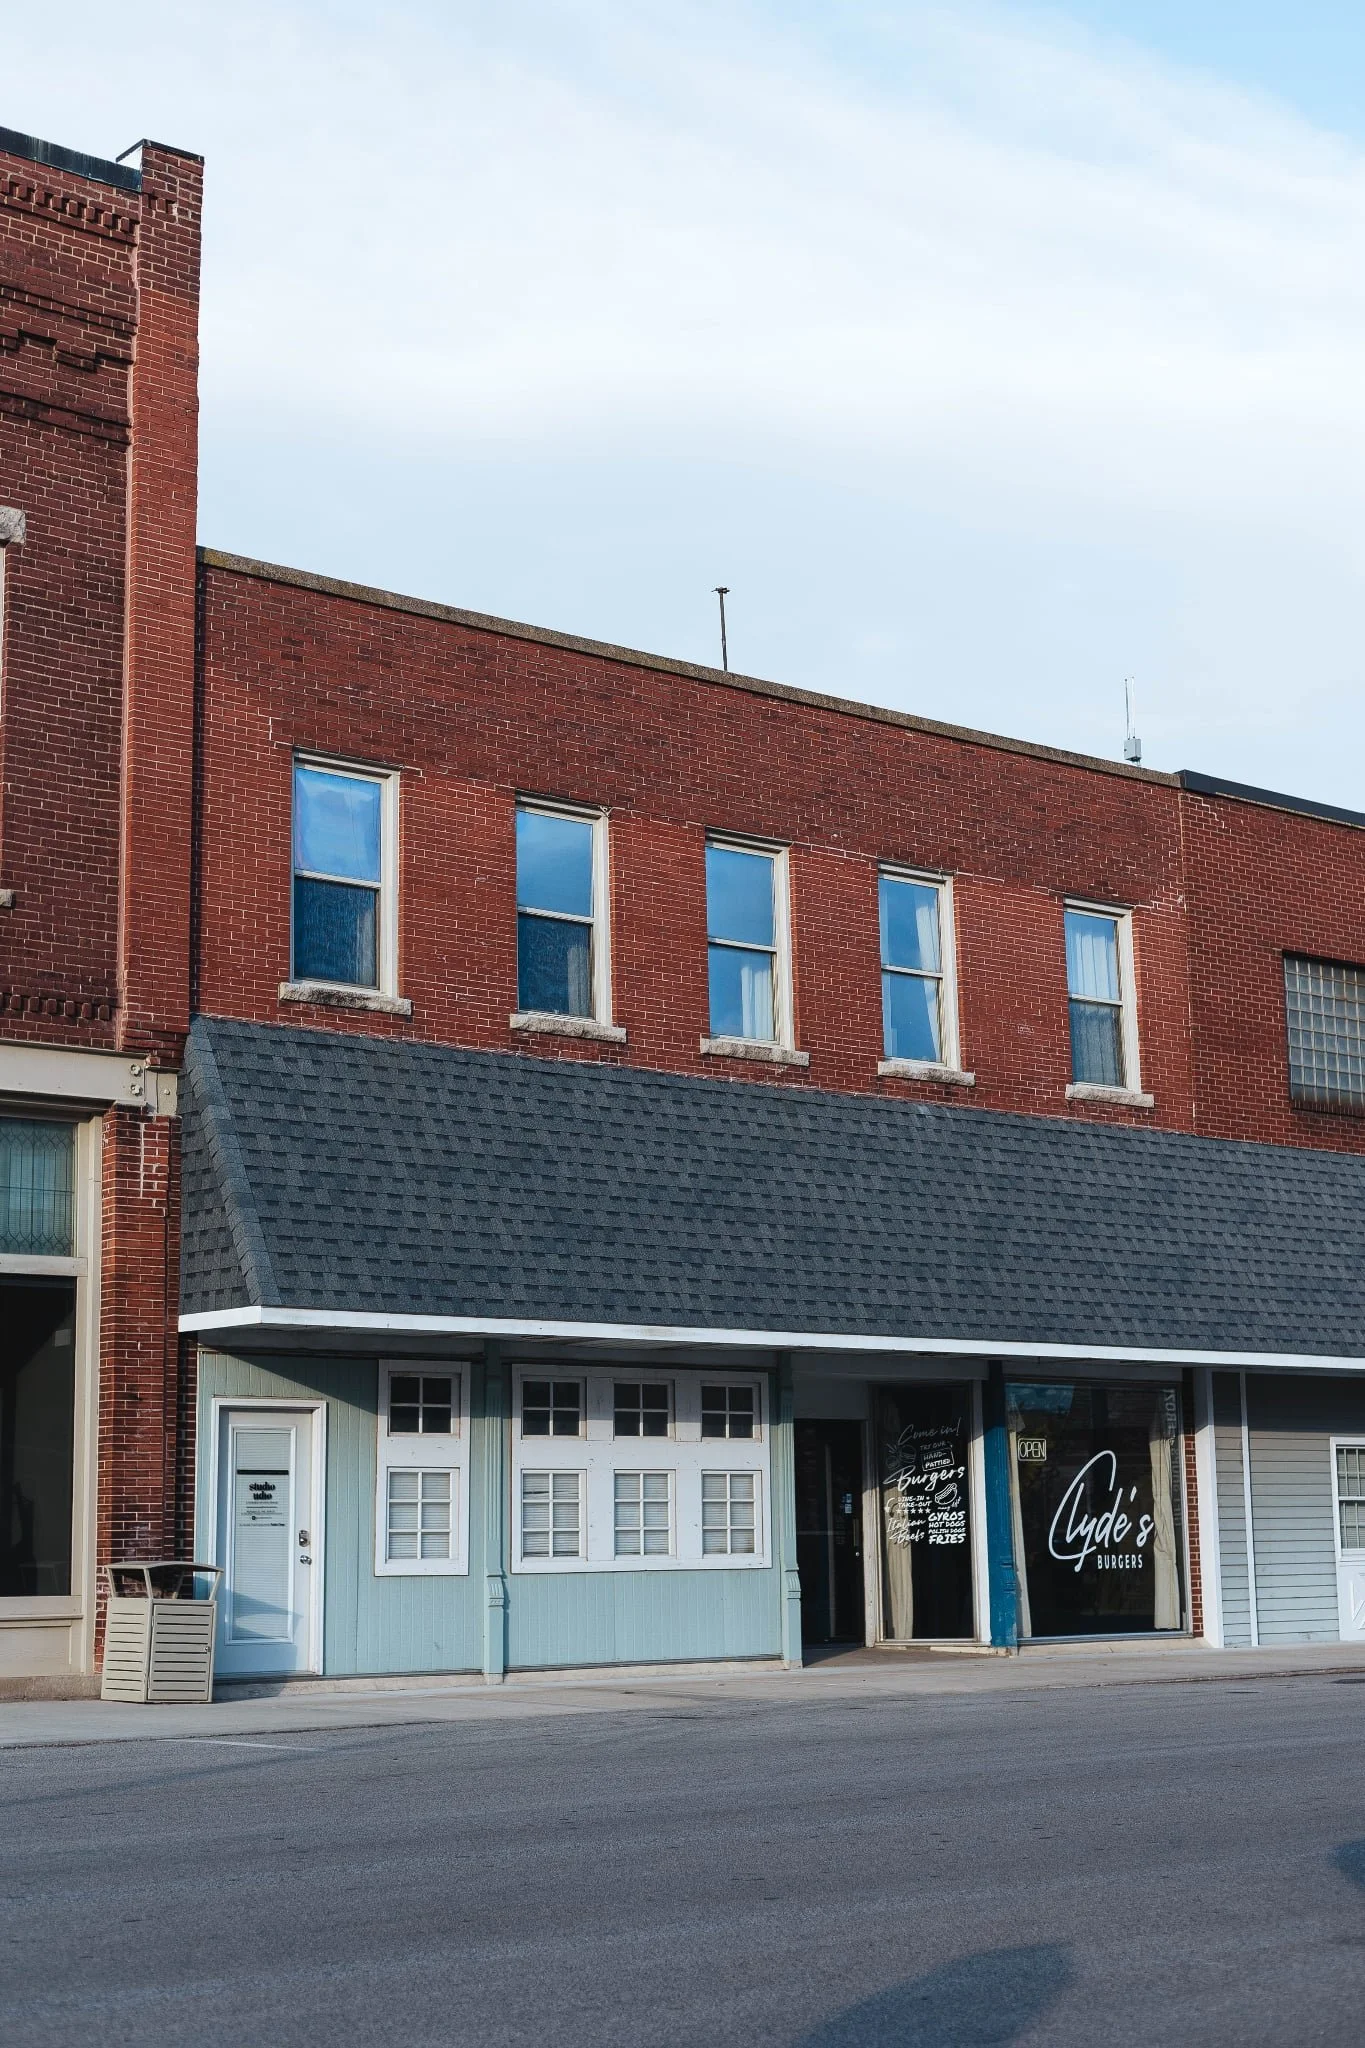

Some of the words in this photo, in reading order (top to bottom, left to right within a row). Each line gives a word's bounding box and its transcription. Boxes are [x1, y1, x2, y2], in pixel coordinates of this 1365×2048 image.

[898, 1424, 938, 1445] Come
[940, 1417, 961, 1436] in!
[1019, 1441, 1045, 1458] OPEN
[925, 1458, 951, 1469] PATTIED
[883, 1465, 965, 1492] Burgers
[898, 1500, 933, 1508] TAKE-OUT
[928, 1510, 966, 1521] GYROS
[1048, 1450, 1155, 1573] Clyde's
[887, 1518, 927, 1532] Italian
[928, 1533, 967, 1545] FRIES
[1097, 1554, 1143, 1569] BURGERS
